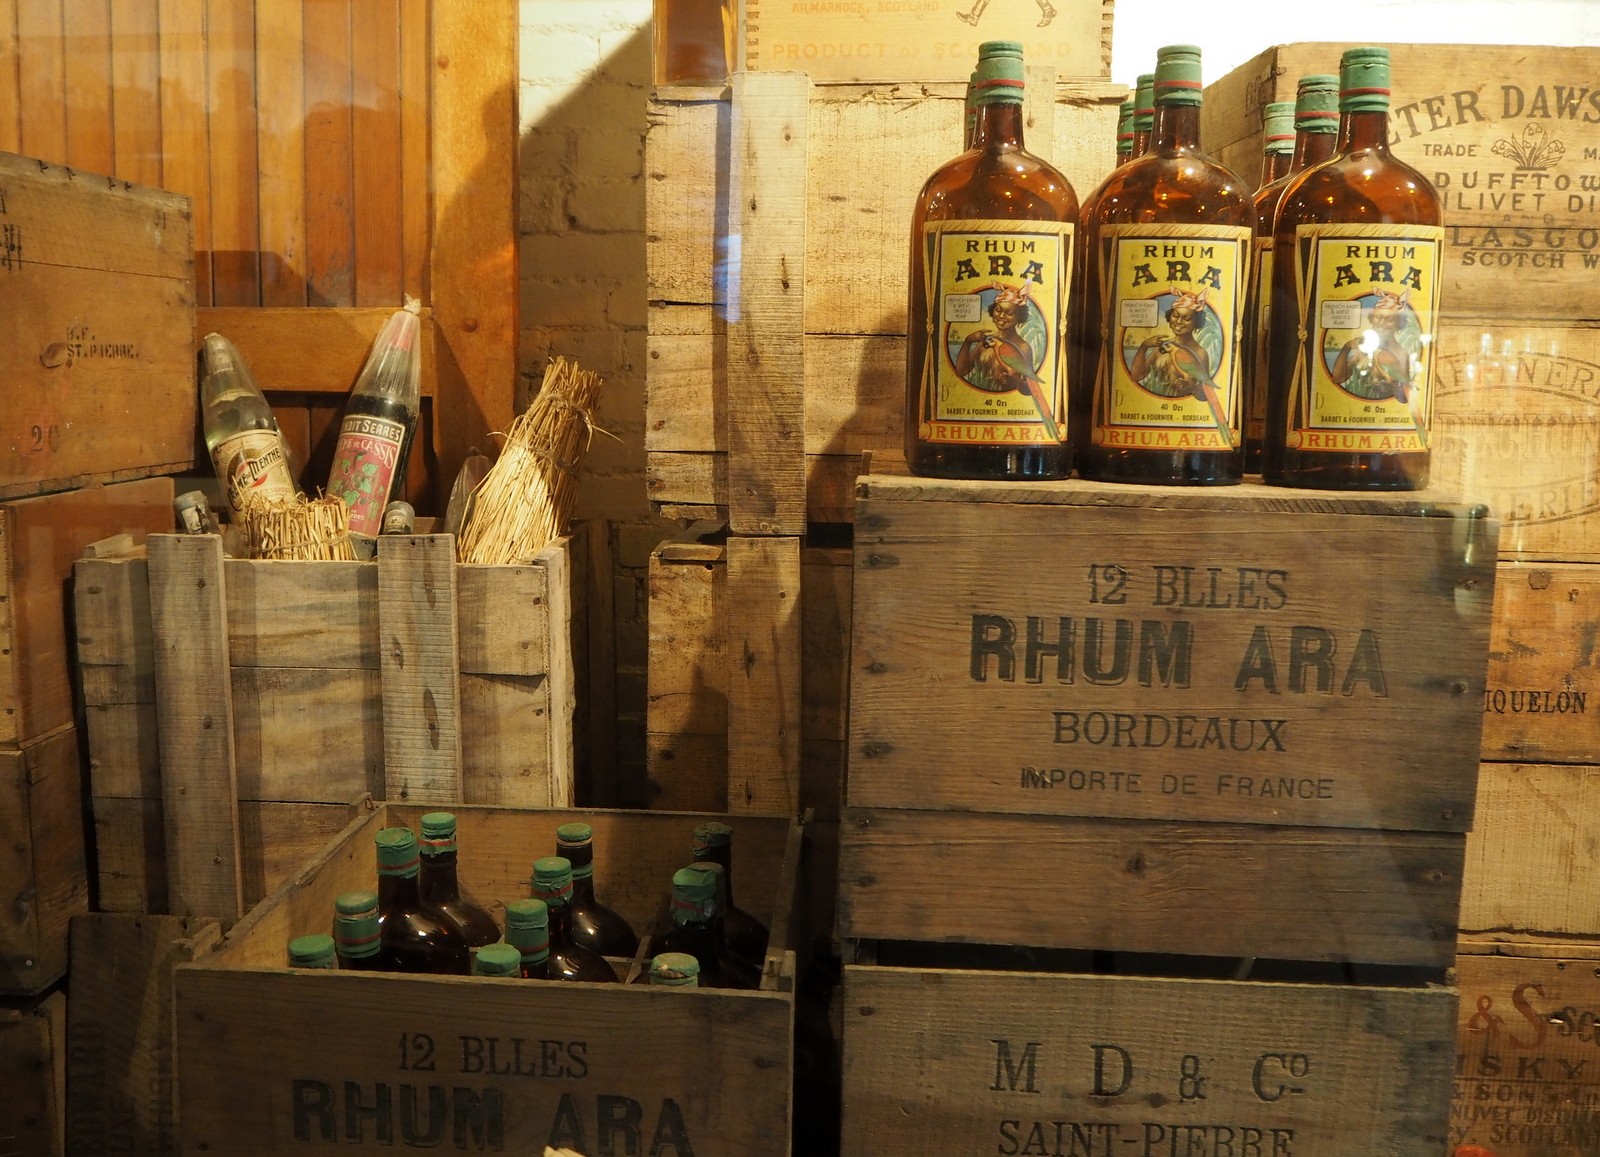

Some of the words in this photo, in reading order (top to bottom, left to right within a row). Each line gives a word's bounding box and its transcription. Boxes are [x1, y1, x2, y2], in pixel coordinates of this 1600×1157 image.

[772, 43, 887, 60] PRODUCT
[934, 42, 1072, 60] SCOAND
[1423, 144, 1478, 157] TRADE
[966, 239, 1036, 253] RHUM
[1144, 244, 1215, 259] RHUM
[1346, 245, 1416, 260] RHUM
[955, 254, 1044, 284] ARA
[1461, 252, 1565, 269] SCOTCH
[1131, 260, 1222, 291] ARA
[1333, 260, 1422, 291] ARA
[946, 407, 966, 416] BARBET
[971, 407, 998, 416] FOURNIER
[1007, 408, 1036, 416] BORDEAUX
[984, 398, 993, 407] 40
[1160, 403, 1169, 411] 40
[1363, 405, 1371, 413] 40
[1120, 413, 1141, 421] BARBET
[1146, 413, 1173, 421] FOURNIER
[1182, 414, 1210, 422] BORDEAUX
[1320, 415, 1342, 424] BARBET
[1348, 415, 1376, 424] FOURNIER
[1384, 416, 1411, 424] BORDEAUX
[362, 419, 401, 441] SERRES
[936, 426, 998, 441] RHUM
[1002, 427, 1045, 441] ARA
[1109, 430, 1171, 446] RHUM
[1177, 432, 1220, 447] ARA
[1308, 433, 1372, 449] RHUM
[1378, 434, 1418, 449] ARA
[360, 439, 397, 469] CASSIS
[247, 447, 281, 482] MENTHE
[1088, 563, 1127, 606] 12
[1152, 565, 1289, 611] BLLES
[969, 614, 1195, 690] RHUM
[1234, 625, 1389, 700] ARA
[1484, 688, 1588, 715] IQUELON
[1052, 711, 1288, 753] BORDEAUX
[1020, 766, 1142, 795] IMPORTE
[1161, 773, 1198, 796] DE
[1216, 774, 1335, 801] FRANCE
[399, 1032, 436, 1072] 12
[458, 1034, 590, 1080] BLLES
[989, 1038, 1042, 1095] M
[1088, 1042, 1134, 1098] D
[1178, 1054, 1207, 1101] &
[291, 1078, 505, 1152] RHUM
[546, 1092, 695, 1157] ARA
[997, 1119, 1298, 1157] SAINT-PIERRE
